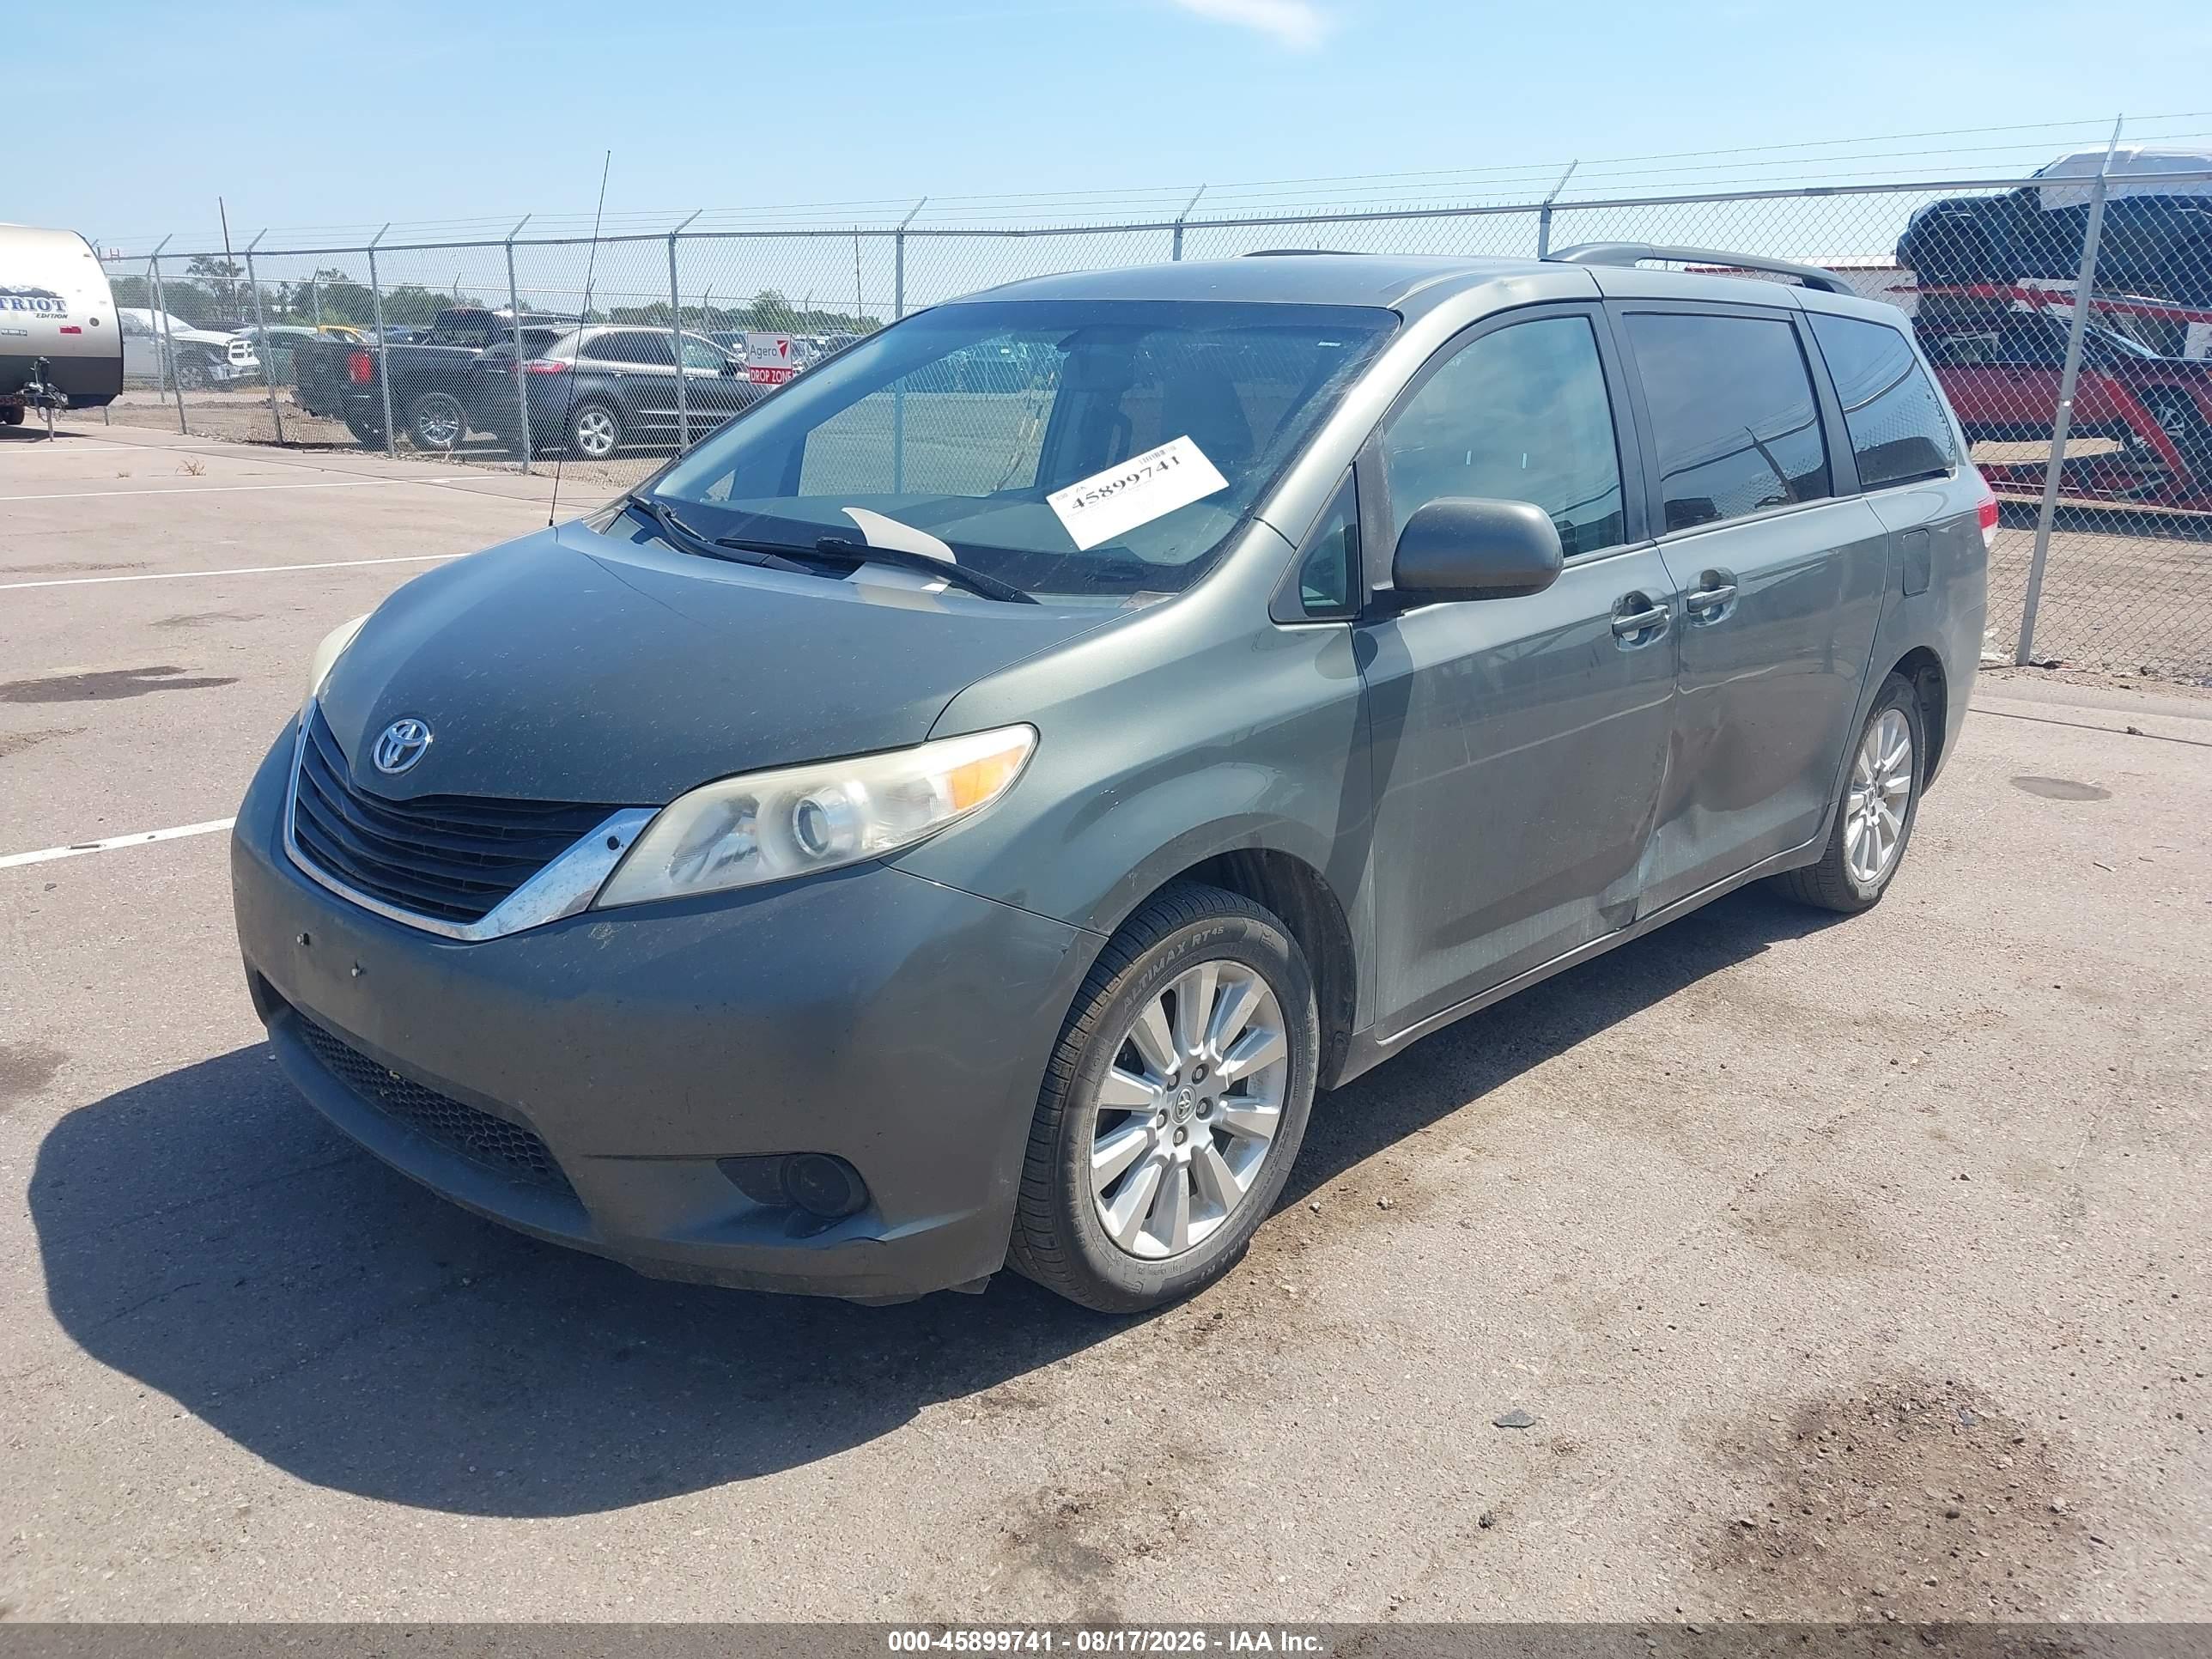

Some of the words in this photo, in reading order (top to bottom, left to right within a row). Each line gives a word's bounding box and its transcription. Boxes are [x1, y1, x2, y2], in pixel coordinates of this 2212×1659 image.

[750, 344, 777, 359] Agero
[750, 369, 770, 382] DROP
[771, 370, 792, 383] ZONE
[1072, 455, 1181, 509] 45899741
[1124, 940, 1187, 1013] ALTIMAX
